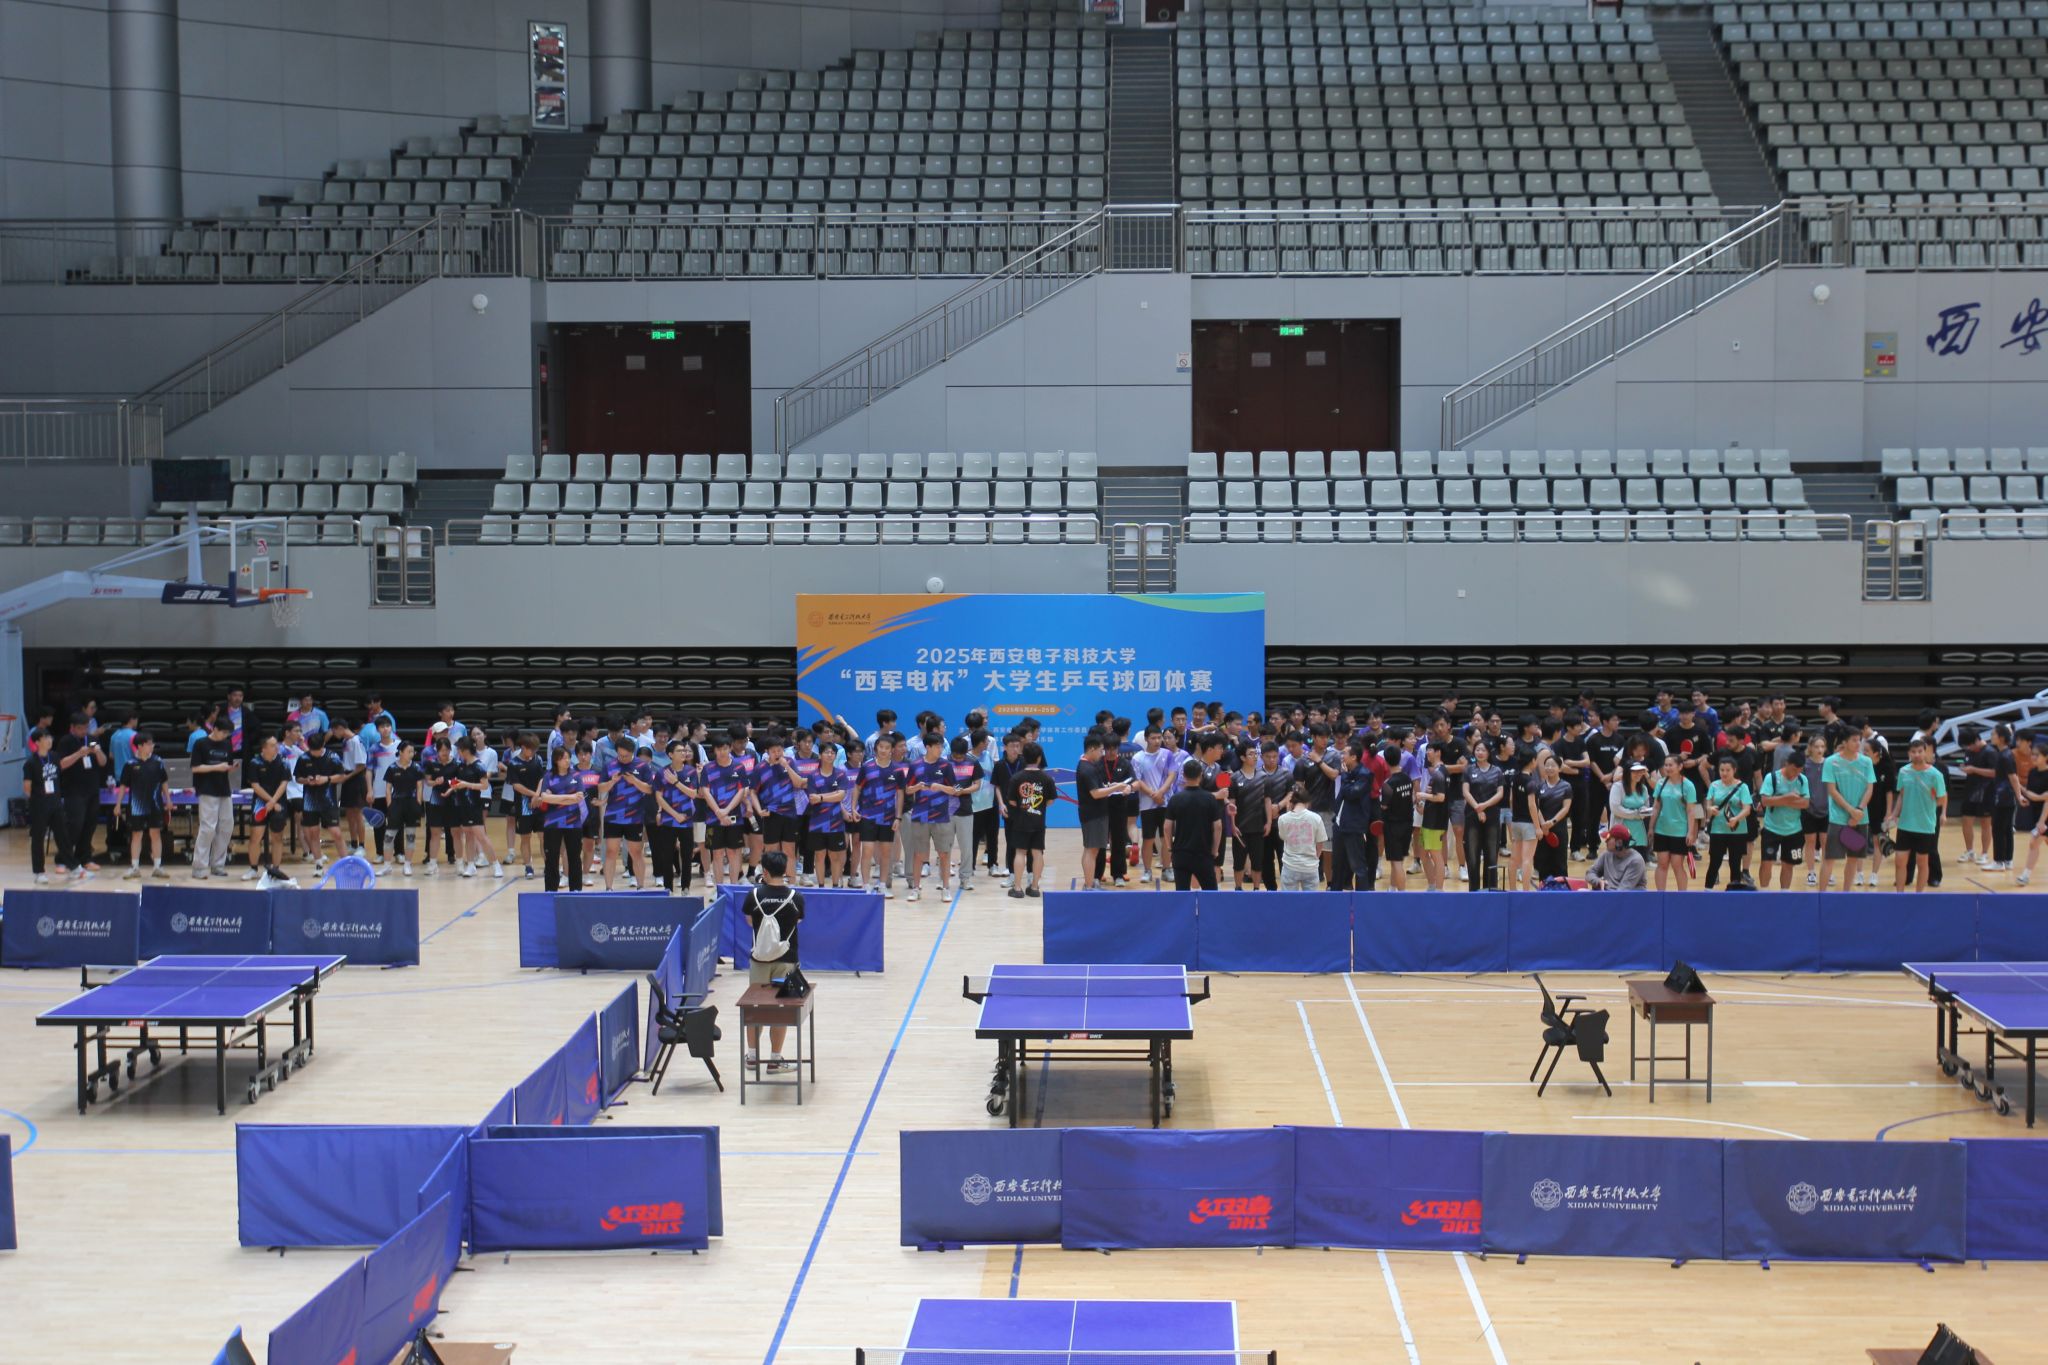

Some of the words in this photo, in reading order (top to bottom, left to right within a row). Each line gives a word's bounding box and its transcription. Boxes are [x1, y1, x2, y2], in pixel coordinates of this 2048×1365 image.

[916, 647, 1137, 665] 2025年西安电子科技大学
[1602, 1202, 1659, 1211] UNIVERSITY
[1823, 1204, 1857, 1212] XIDIAN
[1859, 1203, 1915, 1212] UNIVERSITY
[641, 1220, 685, 1235] DHS
[1226, 1215, 1271, 1230] DHS
[1440, 1219, 1482, 1235] DHS
